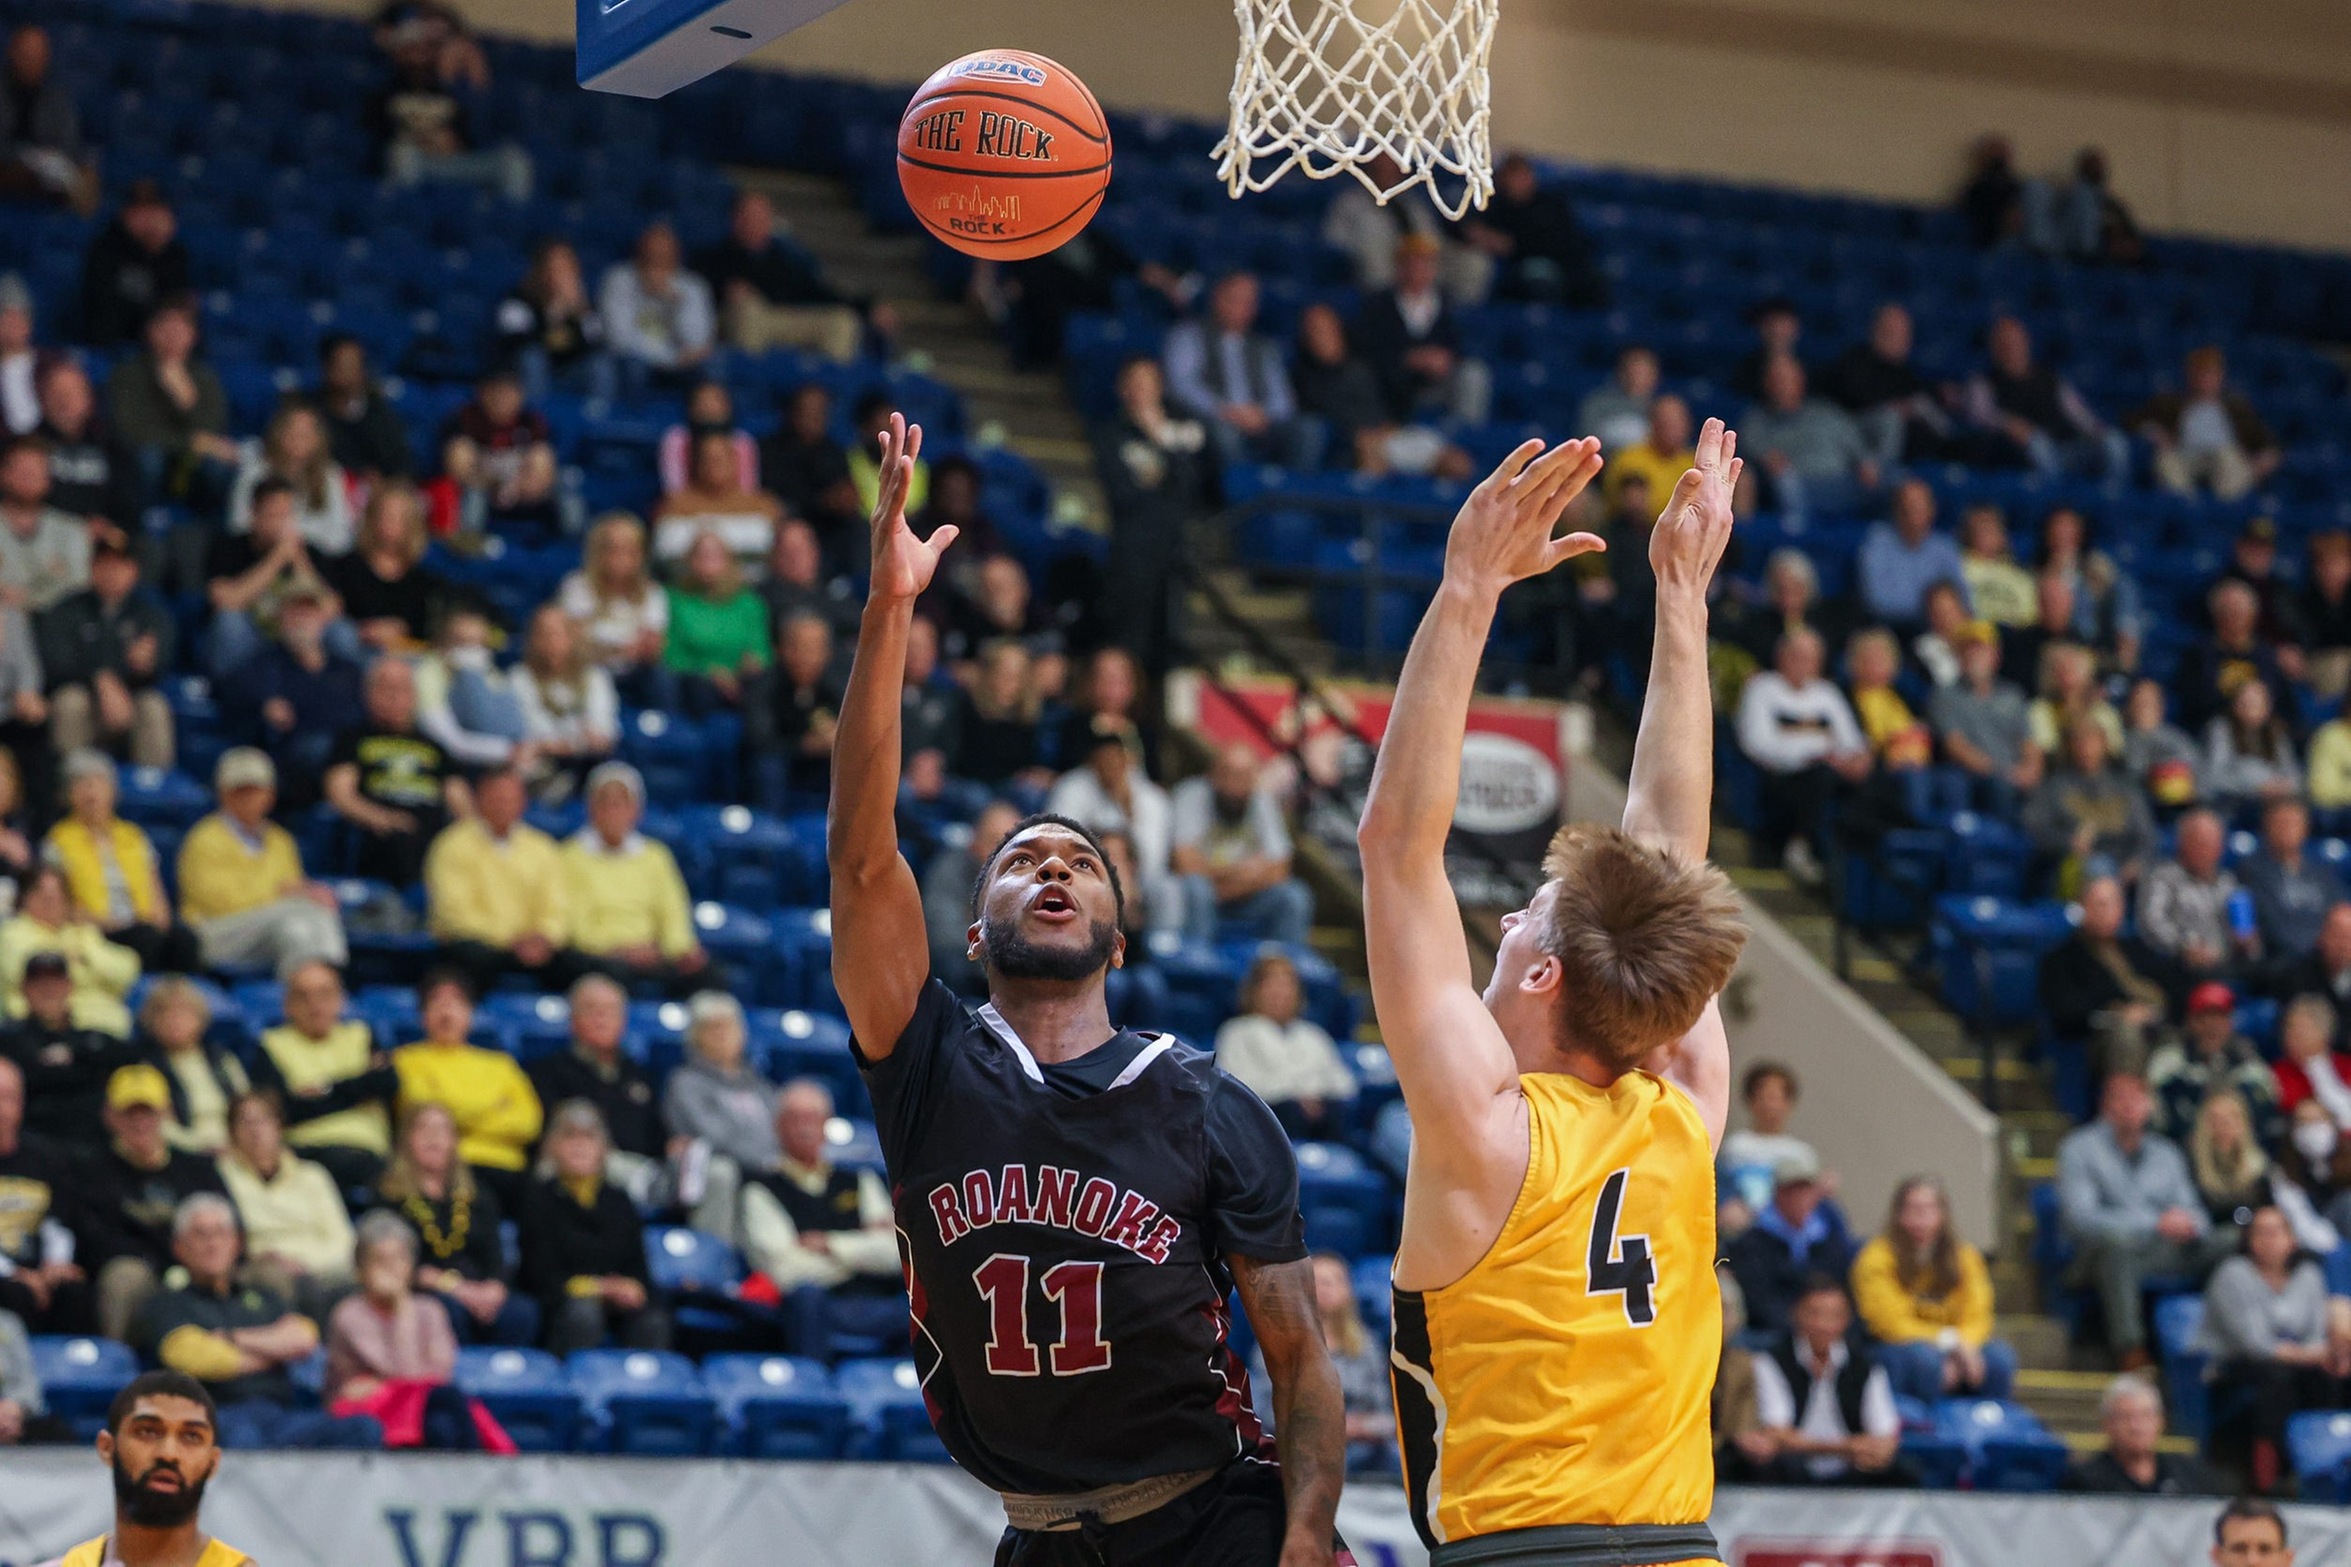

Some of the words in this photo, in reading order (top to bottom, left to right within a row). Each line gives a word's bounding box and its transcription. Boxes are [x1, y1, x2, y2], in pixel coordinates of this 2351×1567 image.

[914, 110, 966, 153] THE
[975, 110, 1054, 161] ROCK
[949, 217, 1006, 235] ROCK
[928, 1164, 1181, 1265] ROANOKE
[1585, 1166, 1659, 1329] 4
[971, 1253, 1112, 1377] 11
